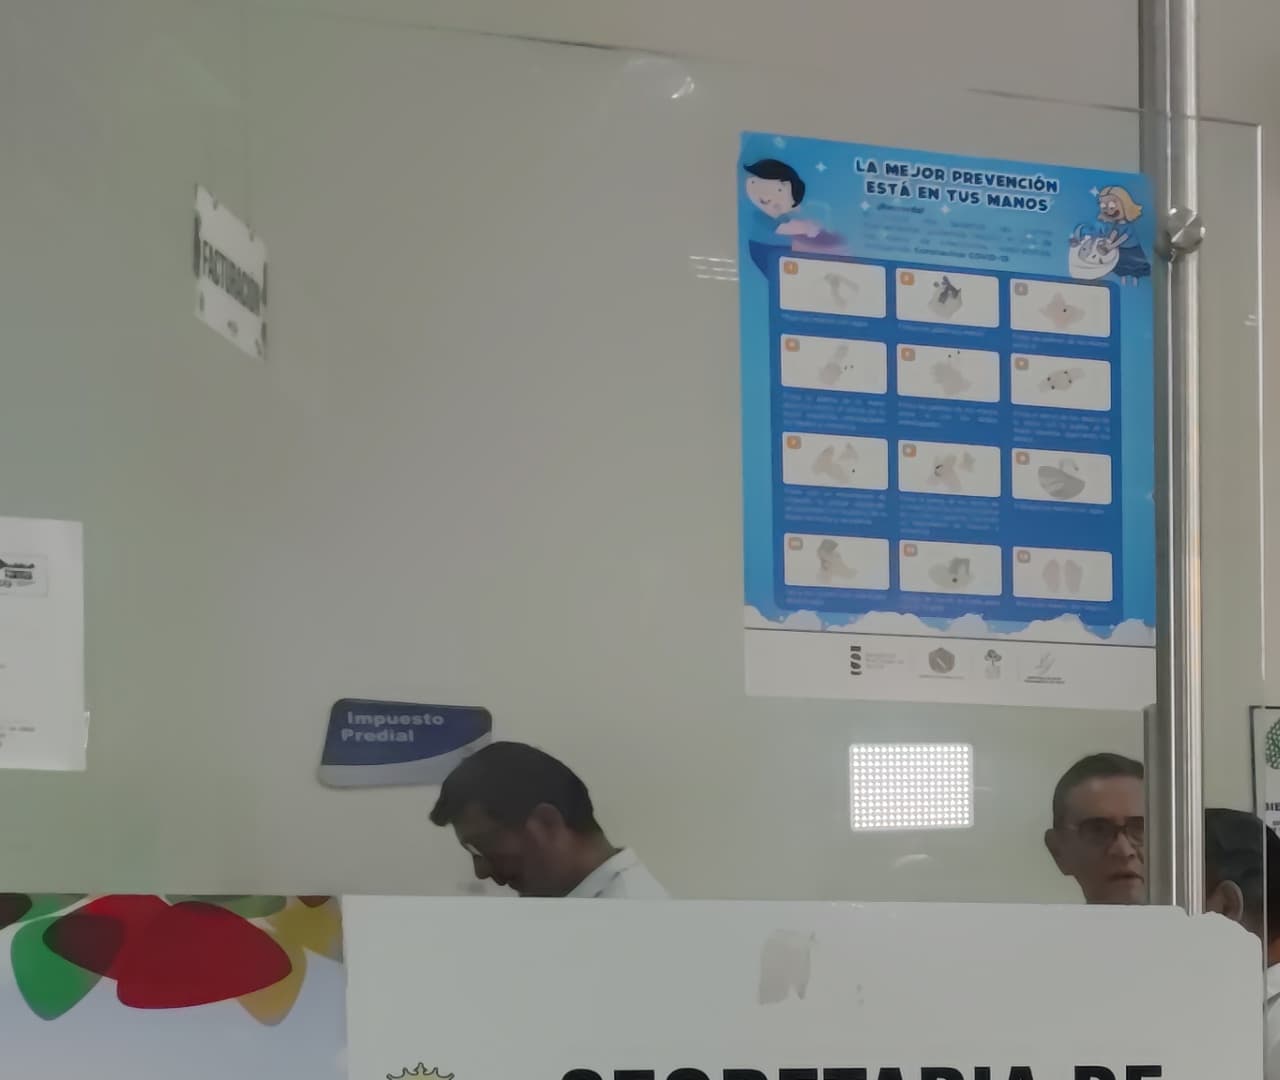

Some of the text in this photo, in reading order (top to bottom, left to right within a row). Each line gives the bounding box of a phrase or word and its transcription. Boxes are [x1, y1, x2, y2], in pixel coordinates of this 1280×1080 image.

[855, 159, 1058, 193] LA MEJOR PREVENCIÓN
[866, 181, 1049, 211] ESTÁ EN TUS MANOS
[347, 711, 445, 728] Impuesto
[341, 728, 415, 743] Predial
